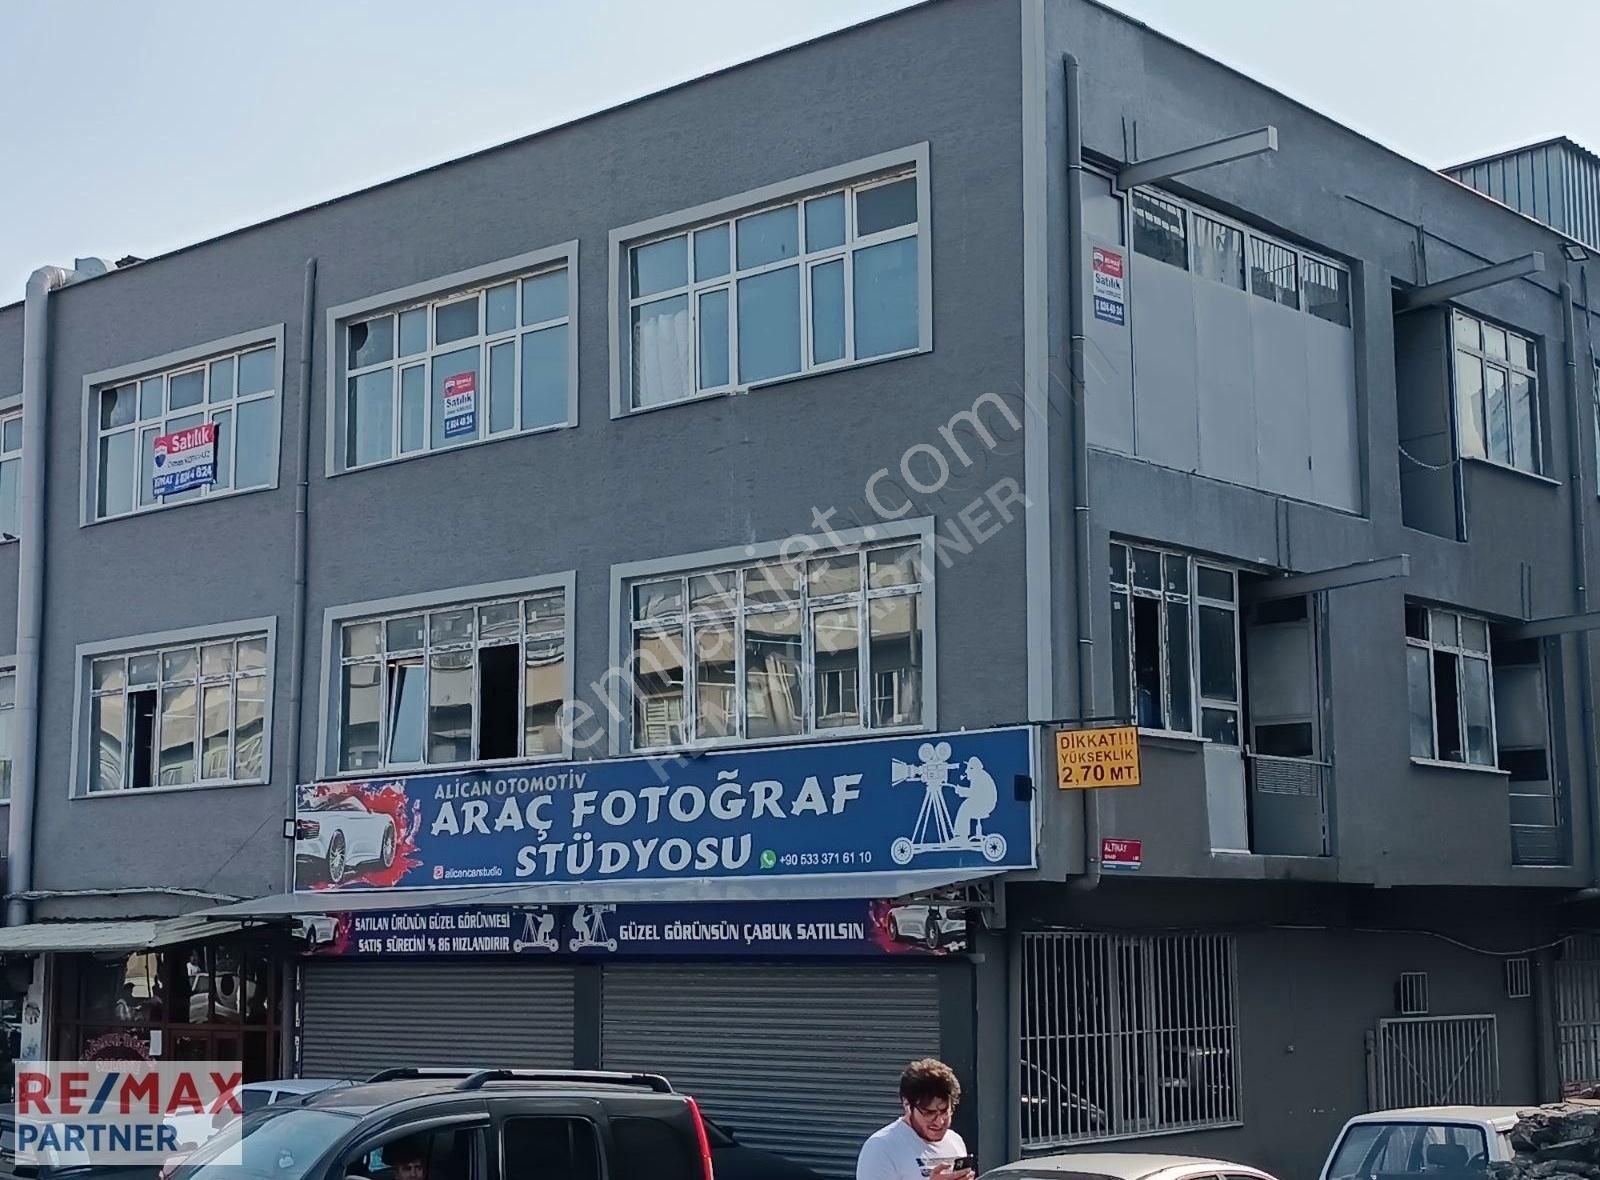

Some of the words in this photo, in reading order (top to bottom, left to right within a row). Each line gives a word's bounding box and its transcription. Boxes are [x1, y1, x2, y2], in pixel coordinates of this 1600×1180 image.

[172, 426, 209, 452] Satılık
[1060, 732, 1134, 750] DİKKAT!!!
[1061, 748, 1134, 764] YÜKSEKLİK
[434, 778, 492, 800] ALİCAN
[494, 769, 586, 796] OTOMOTİV
[1062, 764, 1105, 785] 2,70
[1110, 765, 1138, 781] MT.
[430, 795, 553, 842] ARAÇ
[571, 768, 863, 829] FOTOĞRAF
[515, 831, 752, 878] STÜDYOSU
[780, 854, 798, 866] +90
[800, 853, 819, 865] 533
[821, 852, 840, 865] 371
[842, 851, 855, 864] 61
[858, 850, 872, 863] 10
[355, 917, 389, 931] SATILAN
[391, 913, 427, 930] ÜRÜNÜN
[429, 912, 456, 930] GÜZEL
[458, 911, 510, 929] GÖRÜNMESİ
[619, 921, 660, 941] GÜZEL
[664, 920, 739, 940] GÖRÜNSÜN
[744, 923, 793, 945] ÇABUK
[797, 922, 864, 940] SATILSIN
[358, 938, 382, 955] SATIŞ
[386, 935, 425, 952] SÜRECİNİ
[427, 938, 436, 951] %
[453, 936, 510, 951] HIZLANDIRIR
